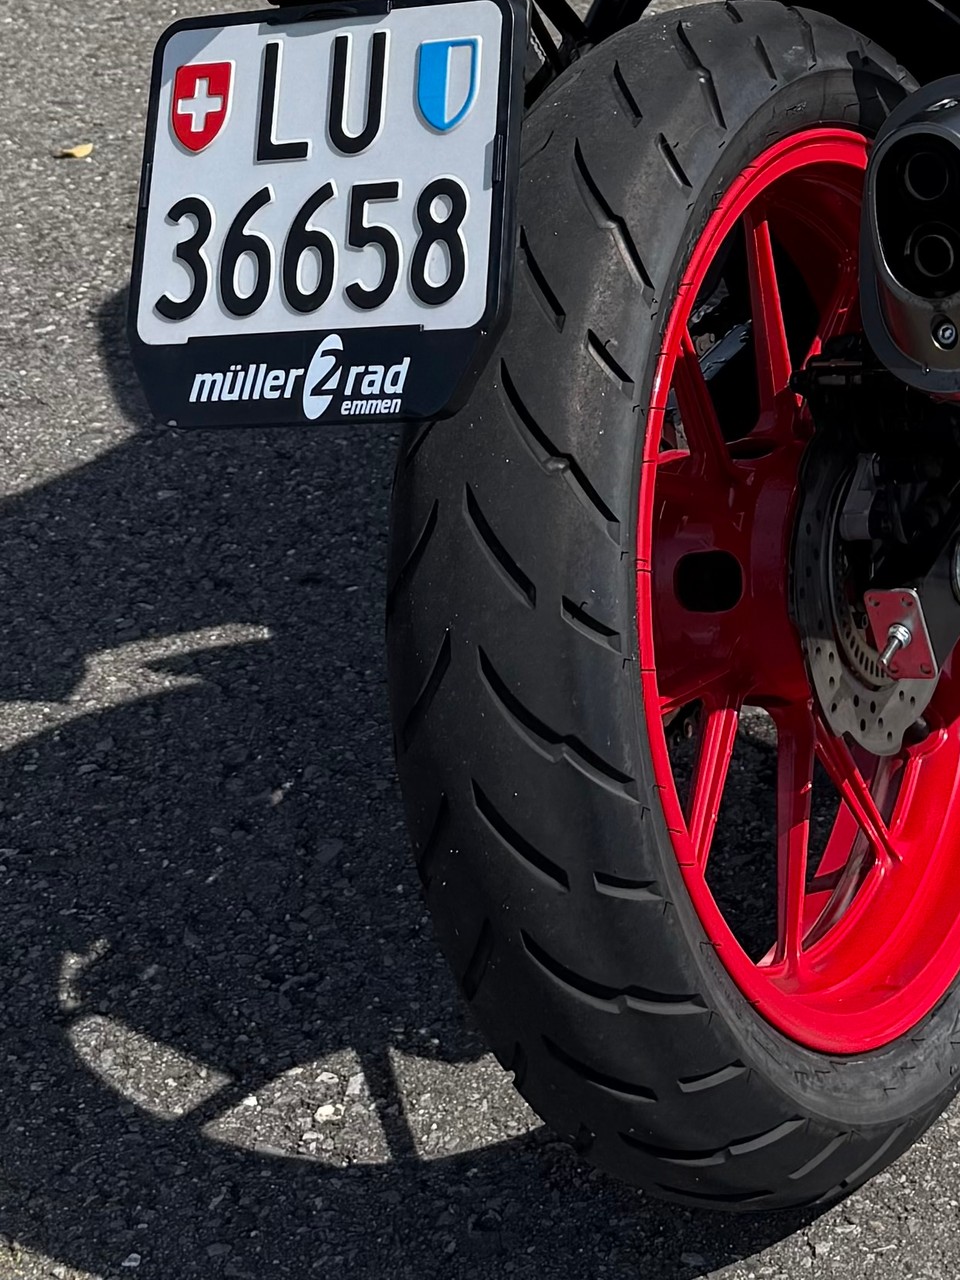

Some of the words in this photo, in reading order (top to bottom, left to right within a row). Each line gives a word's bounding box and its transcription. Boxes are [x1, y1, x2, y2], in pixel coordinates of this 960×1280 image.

[257, 31, 387, 161] LU
[155, 178, 467, 320] 36658
[341, 398, 402, 415] emmen
